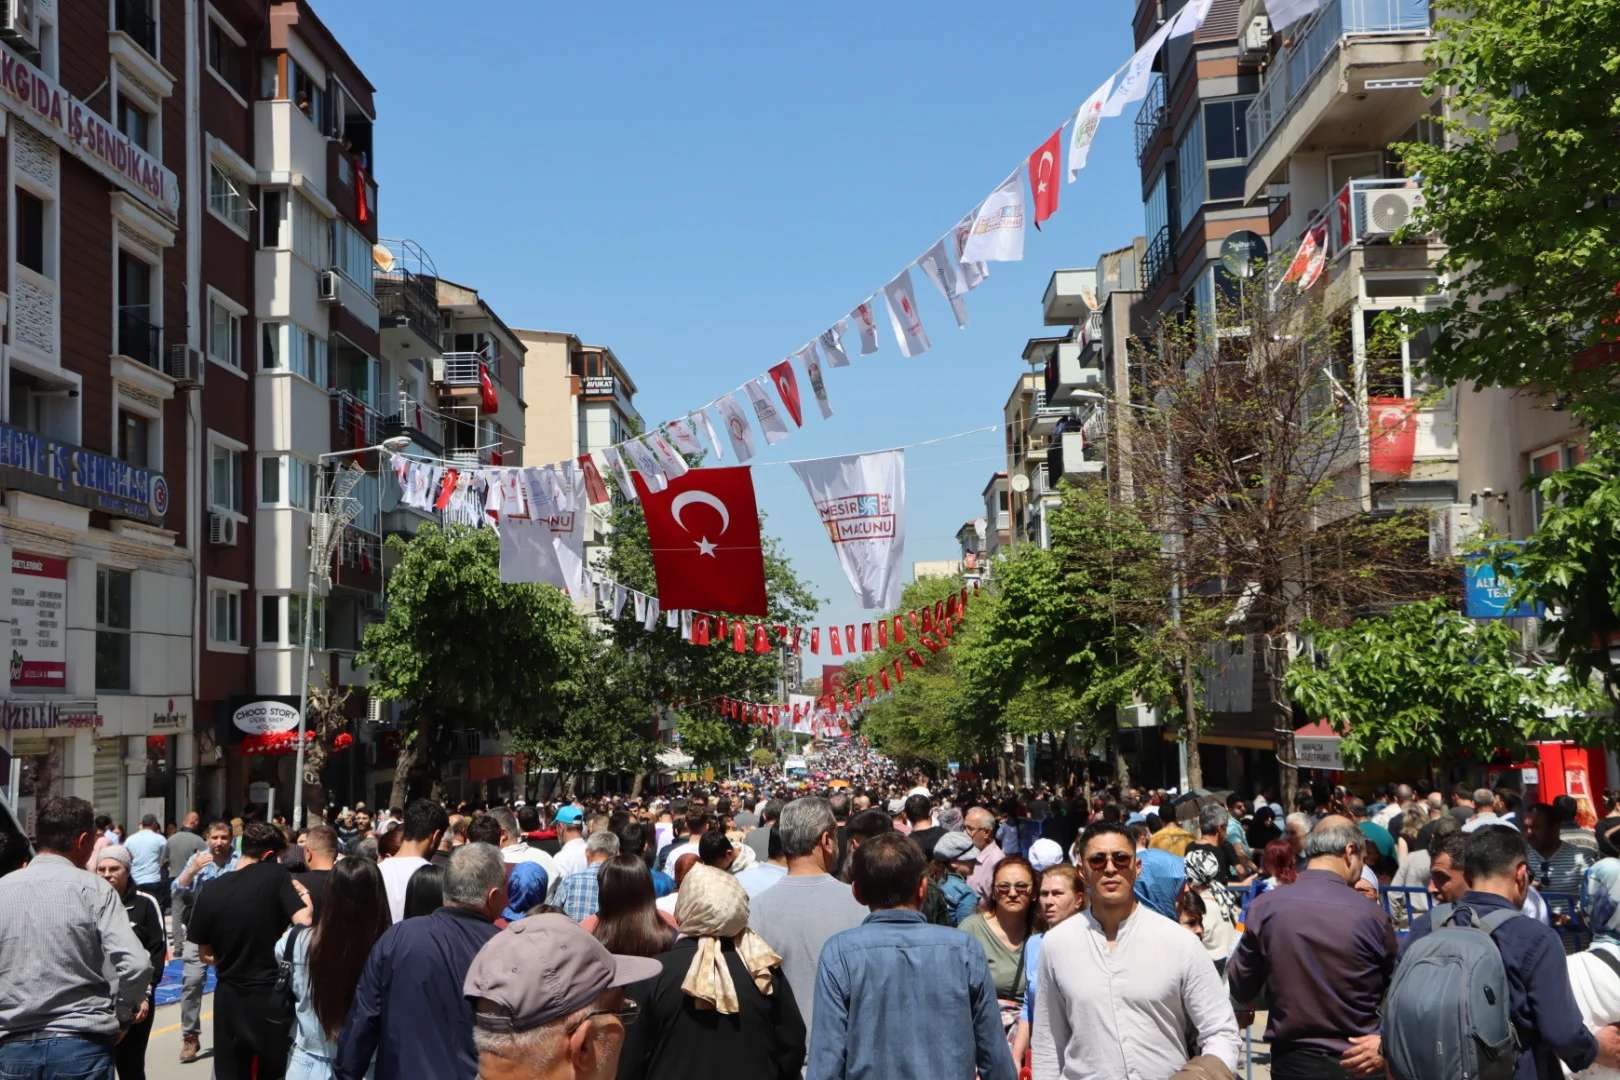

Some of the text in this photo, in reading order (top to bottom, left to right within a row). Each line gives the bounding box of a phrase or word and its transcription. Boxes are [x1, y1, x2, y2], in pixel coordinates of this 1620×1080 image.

[586, 380, 613, 388] AVUKAT
[820, 500, 857, 517] MESİR
[841, 520, 892, 535] MACUNU
[0, 700, 60, 731] ÜZELLİK
[236, 708, 297, 720] CHOCO STORY
